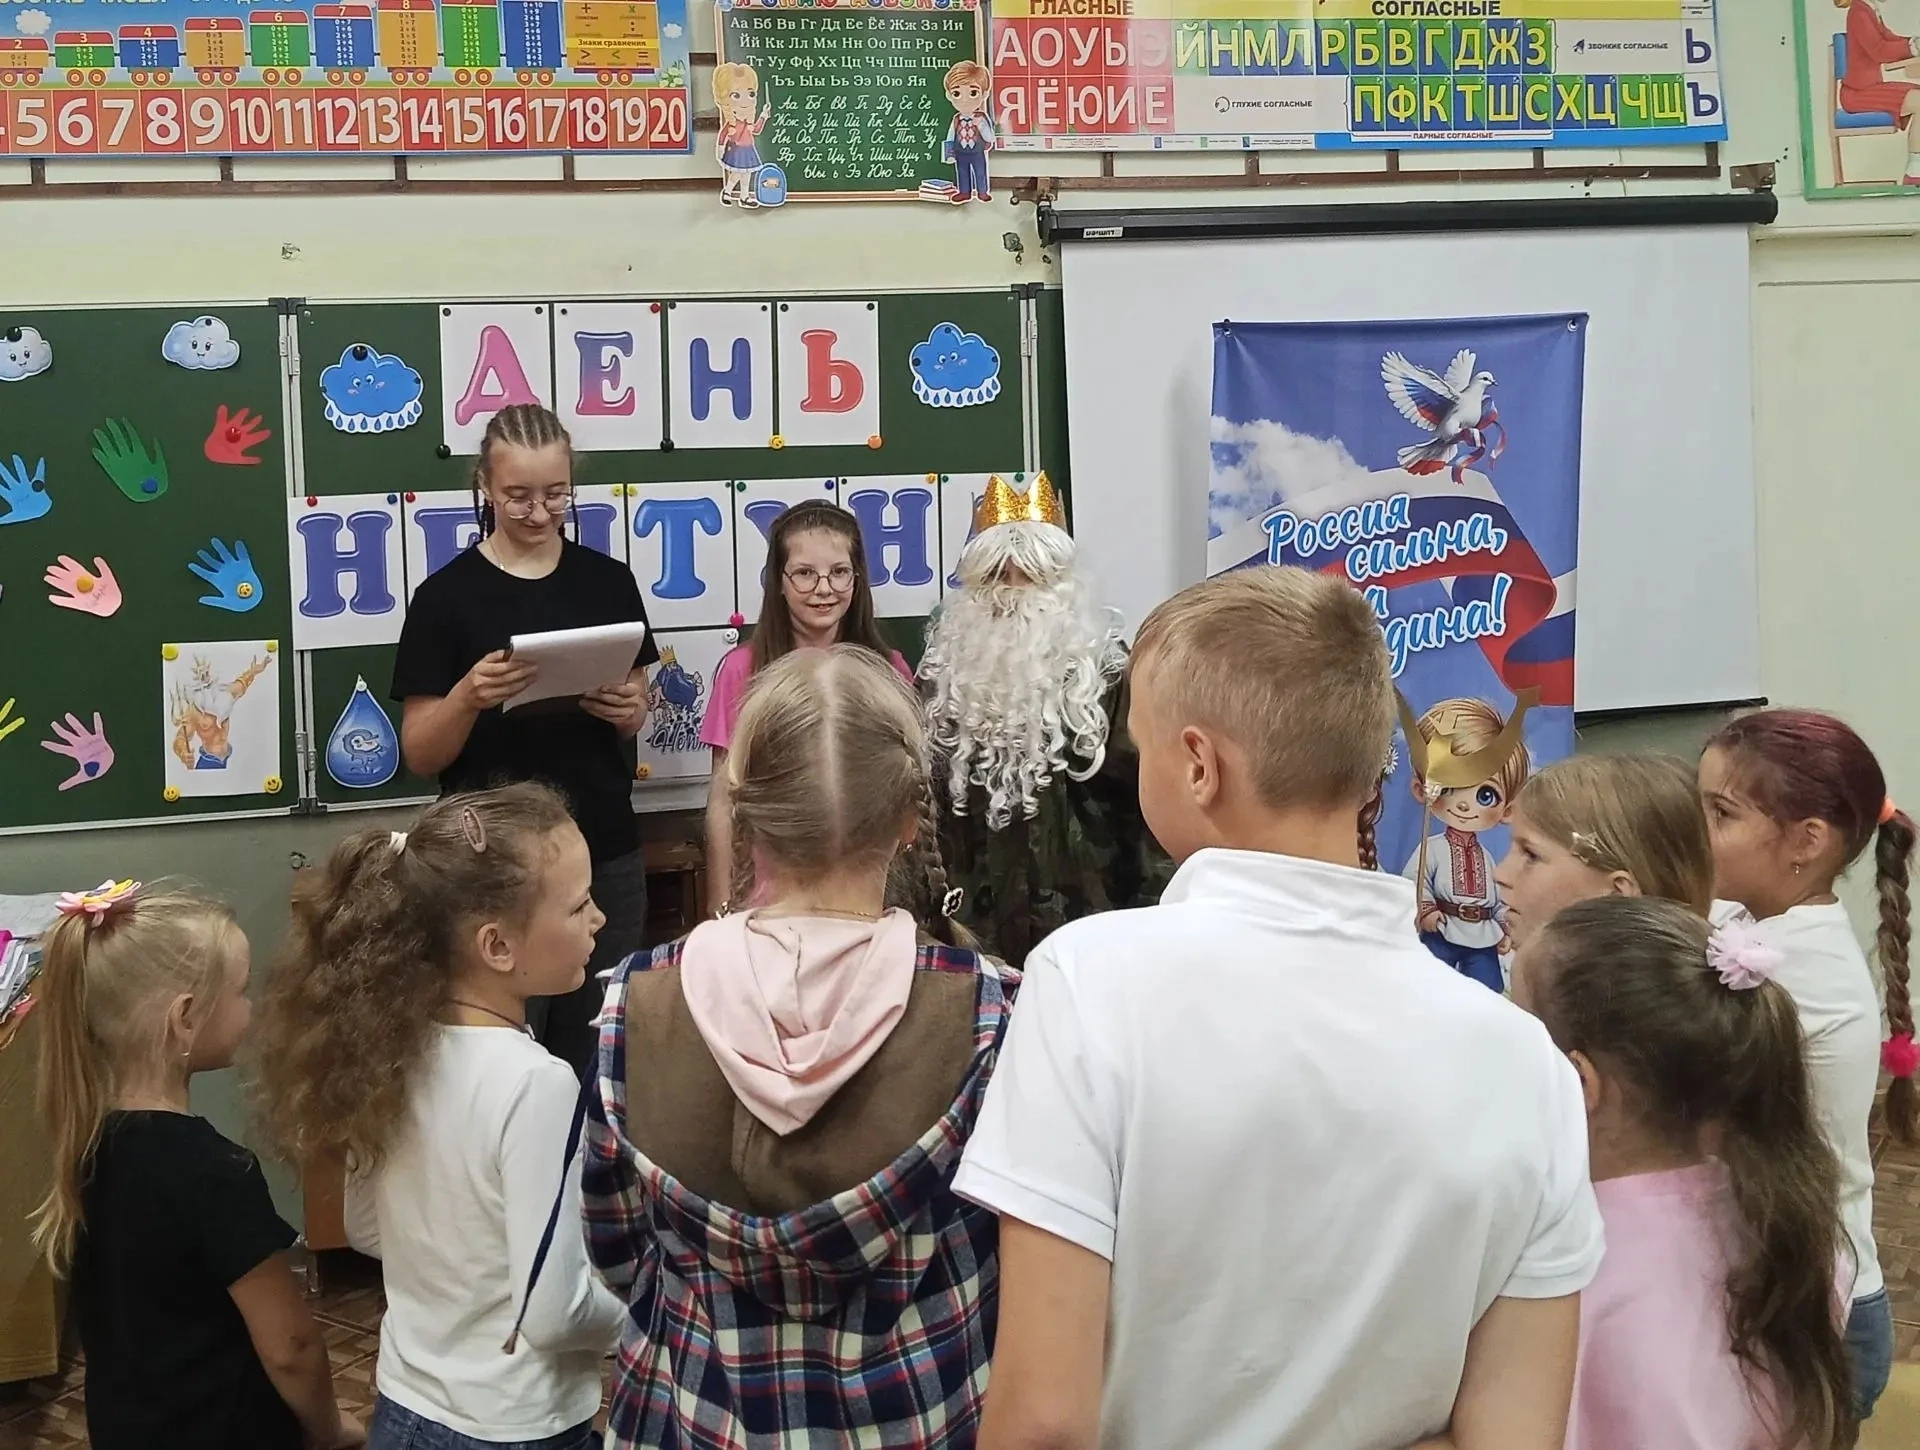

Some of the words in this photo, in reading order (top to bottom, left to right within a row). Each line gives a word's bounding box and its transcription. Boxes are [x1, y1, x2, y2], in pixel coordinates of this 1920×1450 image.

[339, 6, 346, 16] 7
[403, 0, 410, 9] 8
[1029, 0, 1134, 15] ГЛАСНЫЕ
[1371, 0, 1500, 16] СОГЛАСНЫЕ
[209, 19, 217, 29] 5
[275, 12, 283, 22] 6
[730, 17, 749, 29] Аа
[753, 18, 772, 30] Бб
[777, 18, 796, 30] Вв
[801, 18, 817, 30] Гг
[821, 18, 841, 32] Дд
[845, 18, 863, 30] Ее
[868, 16, 886, 30] Ёё
[890, 19, 917, 30] Жж
[921, 19, 938, 31] Зз
[943, 19, 964, 31] Ии
[79, 33, 88, 43] 3
[144, 28, 152, 37] 4
[740, 33, 760, 48] Йй
[765, 37, 785, 48] Кк
[788, 37, 809, 49] Лл
[813, 37, 837, 49] Мм
[842, 37, 863, 49] Нн
[867, 37, 887, 49] Оо
[891, 38, 911, 49] Пп
[916, 38, 934, 52] Рр
[937, 38, 957, 49] Сс
[14, 40, 22, 49] 2
[994, 28, 1028, 67] А
[1031, 27, 1064, 67] О
[1068, 27, 1100, 66] У
[1105, 28, 1136, 66] Ы
[1176, 22, 1206, 68] Й
[1211, 29, 1240, 67] Н
[1244, 29, 1277, 67] М
[1281, 29, 1312, 66] Л
[1321, 29, 1346, 66] Р
[1355, 28, 1380, 66] Б
[1389, 28, 1414, 66] В
[1425, 29, 1445, 65] Г
[1454, 28, 1484, 71] Д
[1488, 28, 1520, 65] Ж
[1526, 28, 1546, 66] З
[1685, 28, 1712, 64] Ь
[746, 55, 764, 67] Тт
[767, 56, 786, 70] Уу
[790, 56, 814, 71] Фф
[818, 56, 837, 67] Хх
[841, 56, 862, 69] Цц
[865, 56, 884, 68] Чч
[888, 57, 917, 68] Шш
[921, 57, 951, 70] Щщ
[771, 75, 795, 87] Ъъ
[799, 75, 826, 87] Ыы
[830, 75, 850, 87] Ьь
[853, 75, 872, 87] Ээ
[876, 75, 903, 87] Юю
[907, 75, 927, 87] Яя
[778, 95, 799, 109] Аа
[805, 95, 825, 109] Бб
[830, 95, 847, 109] Вв
[855, 95, 870, 109] Гг
[876, 95, 894, 115] Дд
[900, 95, 913, 109] Ее
[1000, 87, 1026, 125] Я
[1037, 78, 1060, 125] Ё
[1068, 85, 1103, 125] Ю
[1107, 86, 1136, 124] И
[1145, 86, 1168, 124] Е
[1264, 100, 1313, 108] СОГЛАСНЫЕ
[1354, 85, 1381, 122] П
[1387, 84, 1416, 123] Ф
[1423, 85, 1448, 122] К
[1456, 84, 1482, 122] Т
[1488, 84, 1518, 122] Ш
[1525, 84, 1548, 121] С
[1556, 84, 1582, 120] Х
[1587, 83, 1616, 125] Ц
[1622, 84, 1648, 119] Ч
[1652, 83, 1685, 123] Щ
[1686, 82, 1719, 117] Ъ
[16, 98, 49, 146] 5
[58, 97, 94, 146] 6
[102, 99, 135, 146] 7
[146, 97, 181, 145] 8
[190, 97, 224, 145] 9
[230, 97, 271, 144] 10
[275, 98, 313, 144] 11
[317, 97, 359, 144] 12
[360, 96, 400, 144] 13
[402, 97, 443, 144] 14
[445, 97, 485, 143] 15
[487, 97, 526, 142] 16
[528, 98, 566, 142] 17
[569, 96, 606, 142] 18
[609, 97, 647, 142] 19
[650, 97, 687, 142] 20
[772, 113, 799, 127] Жж
[804, 113, 817, 133] Зз
[822, 113, 839, 127] Ии
[844, 113, 861, 127] Йй
[867, 113, 883, 127] Кк
[888, 112, 909, 127] Лл
[913, 112, 940, 127] Мм
[771, 128, 791, 144] Нн
[796, 129, 812, 144] Оо
[816, 128, 839, 144] Пп
[846, 128, 862, 144] Рр
[871, 129, 885, 144] Сс
[892, 128, 917, 144] Тт
[922, 128, 937, 149] Уу
[455, 325, 864, 426] ДЕНЬ
[1263, 494, 1411, 565] Россия
[1345, 513, 1508, 580] сильна,
[1378, 573, 1512, 678] дина!
